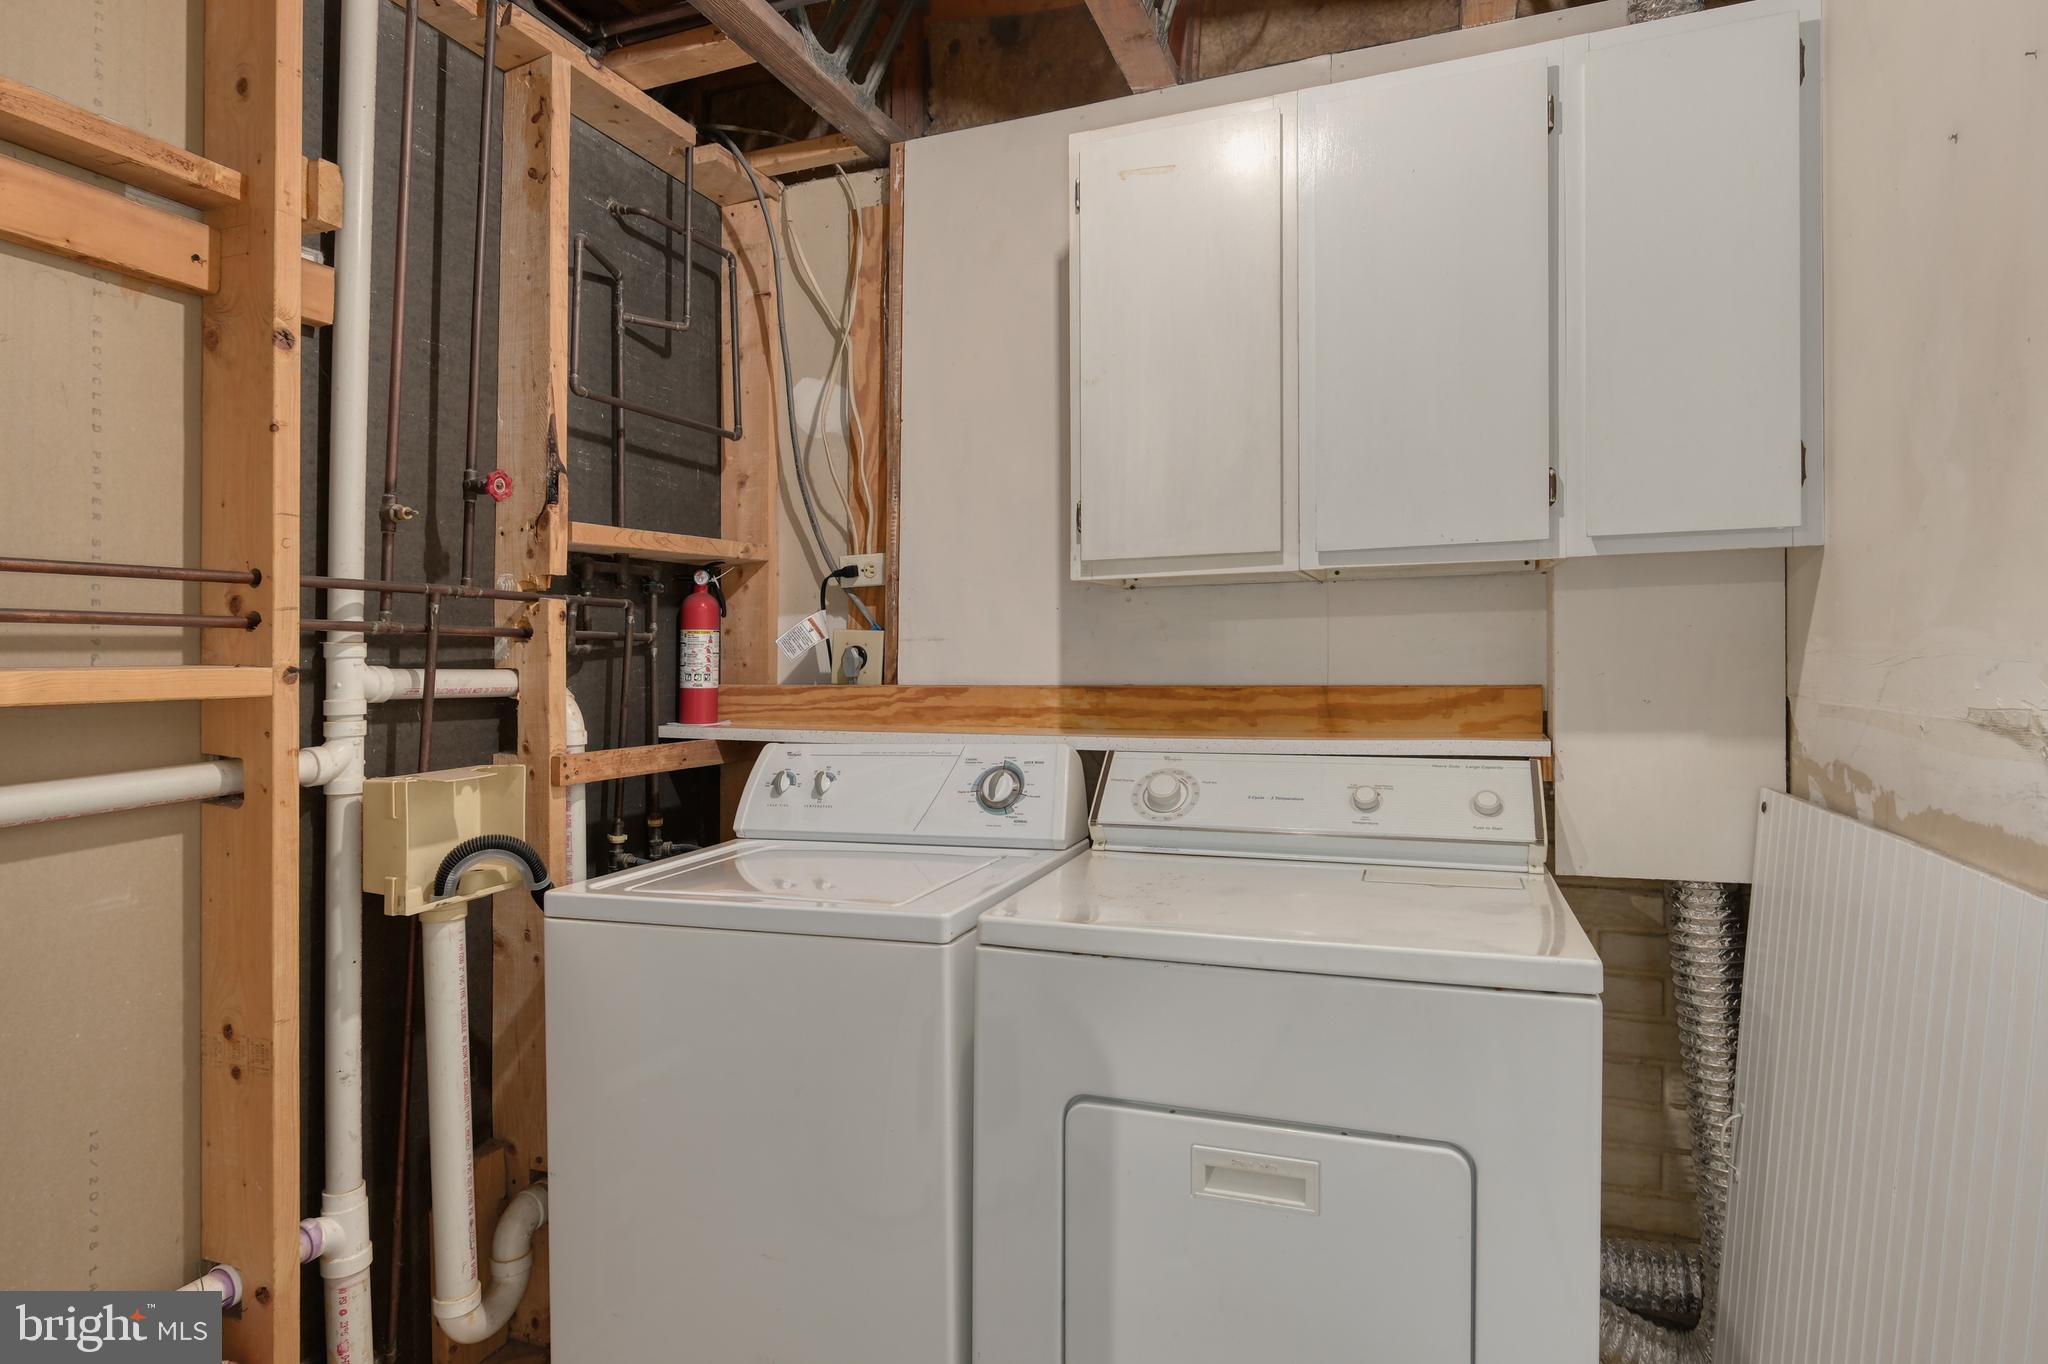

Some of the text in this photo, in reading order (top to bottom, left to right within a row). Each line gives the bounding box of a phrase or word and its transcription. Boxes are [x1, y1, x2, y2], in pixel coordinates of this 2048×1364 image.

[91, 314, 102, 433] RECYCLED
[91, 450, 102, 521] PAPER
[91, 538, 102, 607] SICE
